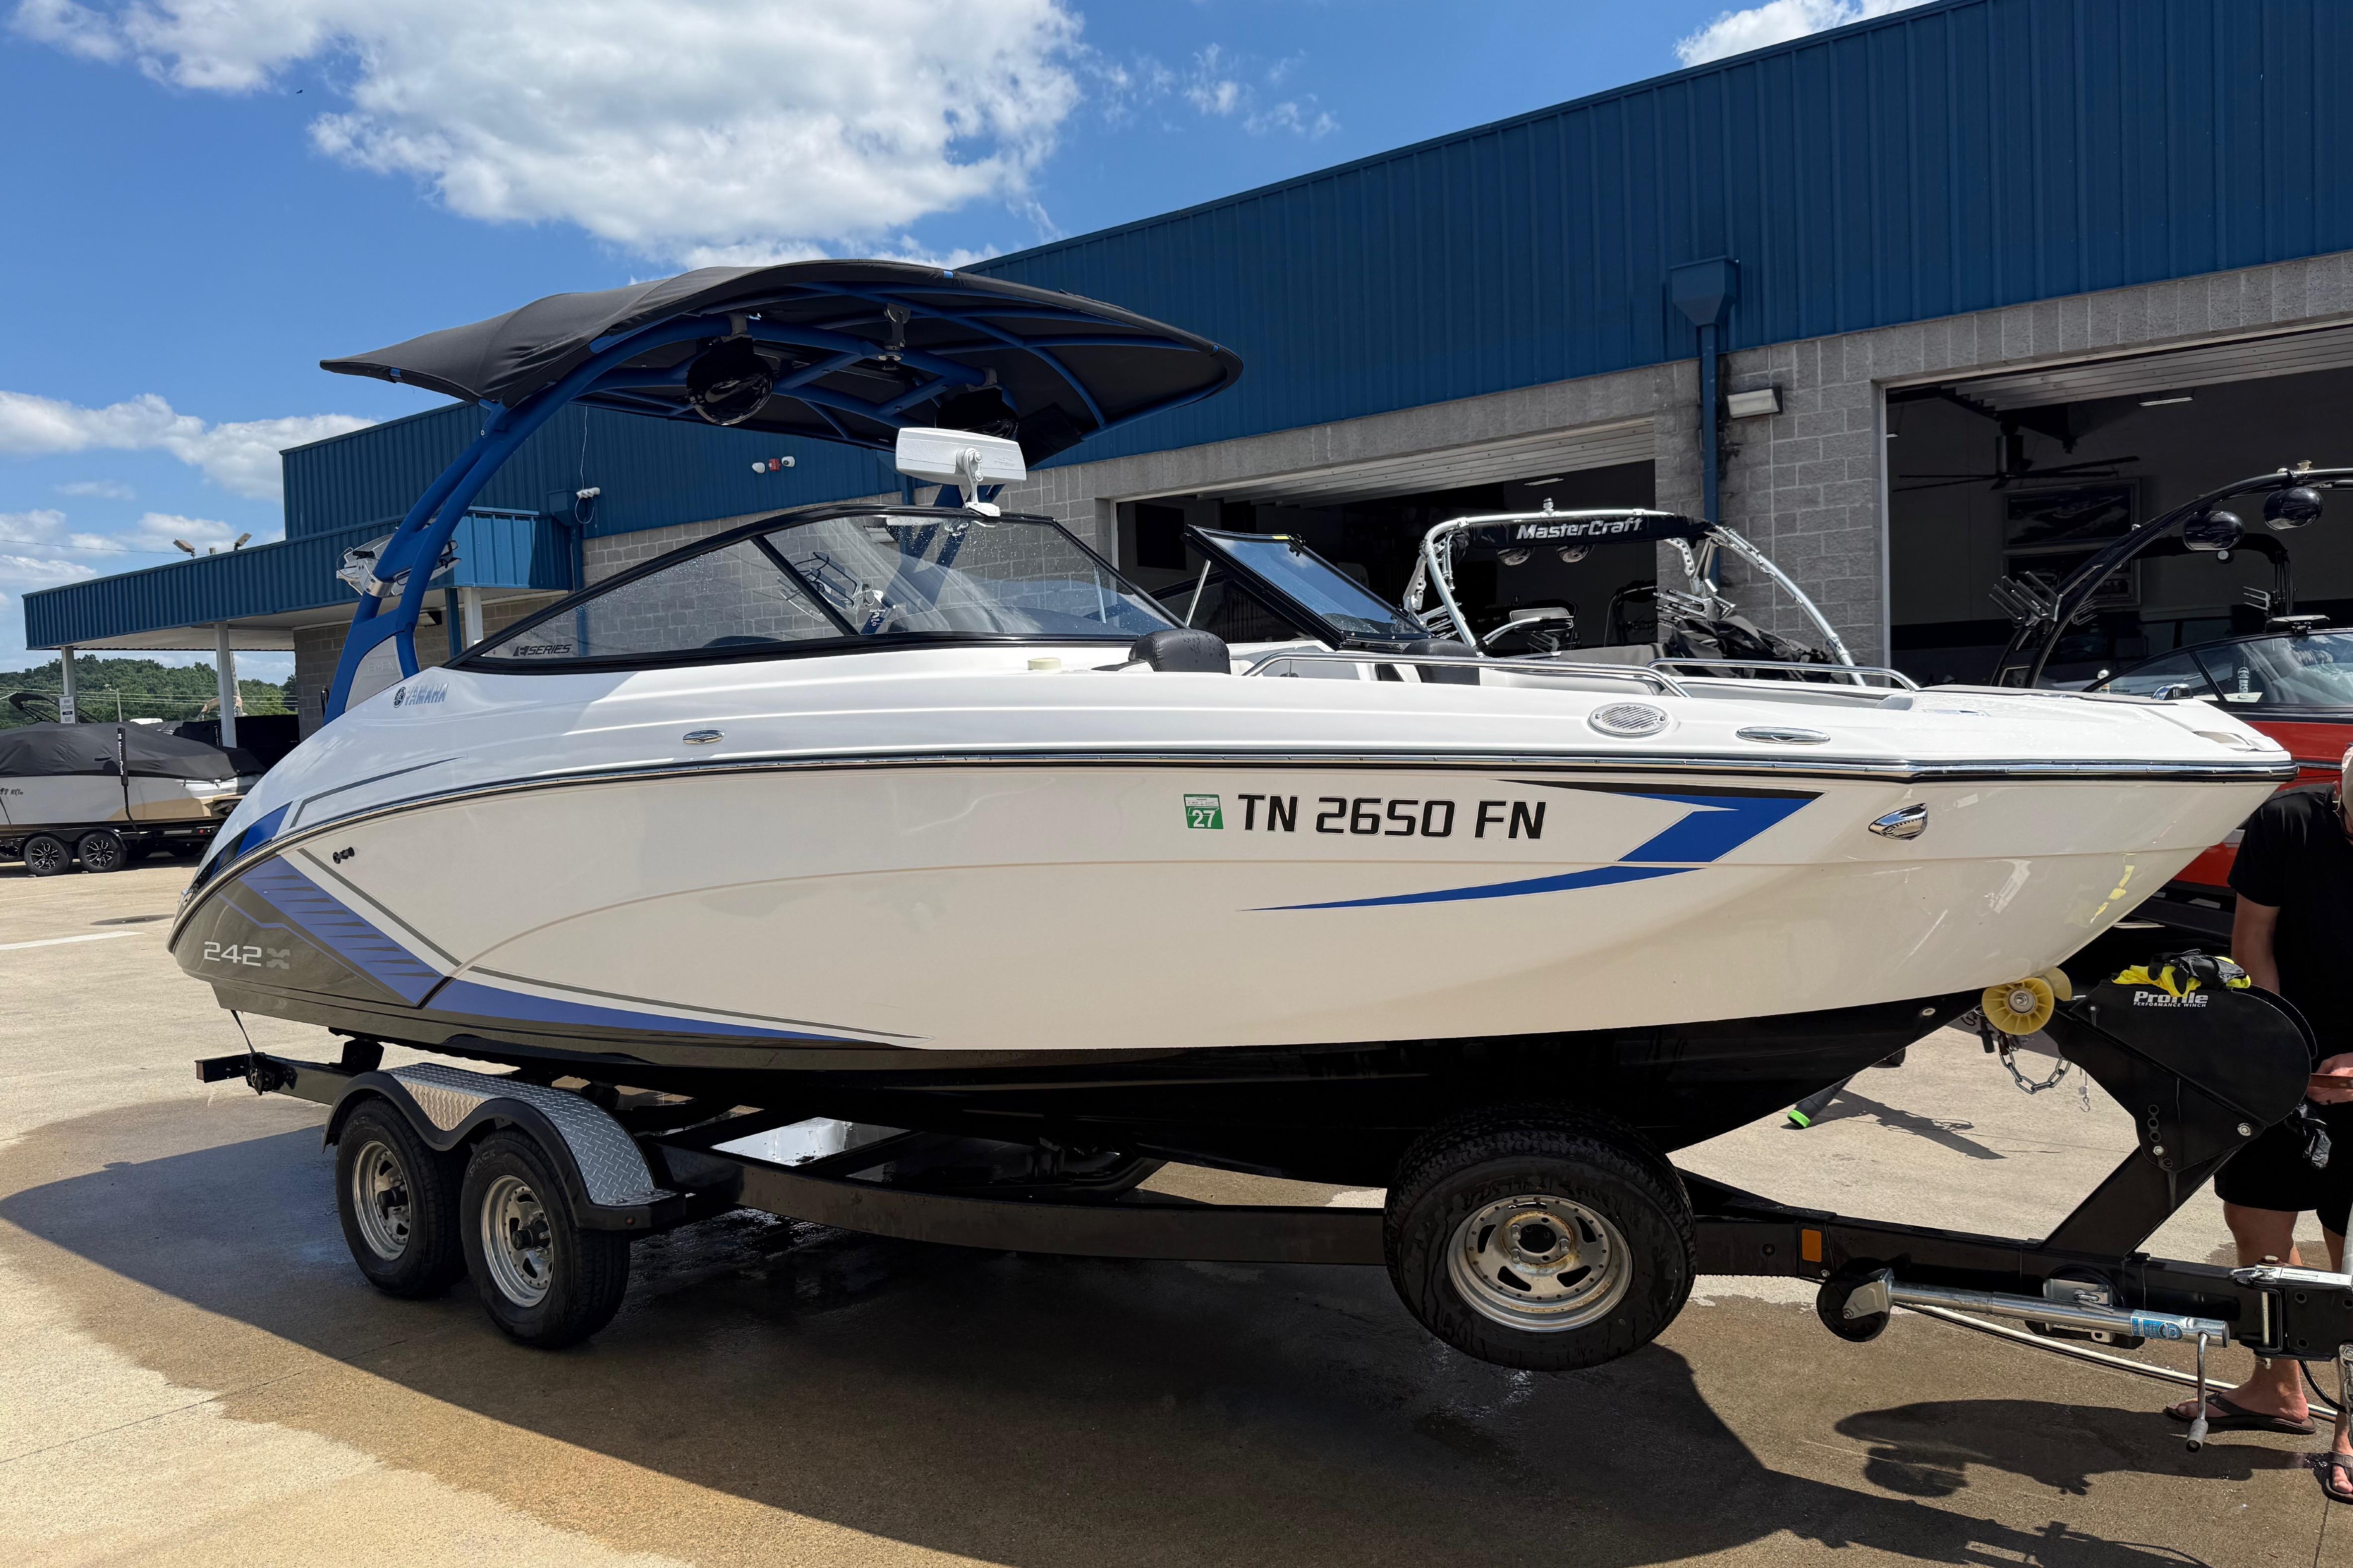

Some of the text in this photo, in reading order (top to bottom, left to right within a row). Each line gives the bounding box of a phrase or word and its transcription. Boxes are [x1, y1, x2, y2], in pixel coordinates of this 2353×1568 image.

[1517, 518, 1642, 539] MasterCraft
[527, 644, 572, 655] SERIES
[404, 683, 449, 706] YAMAHA
[1192, 809, 1216, 827] 27
[1237, 794, 1547, 840] TN 2650 FN
